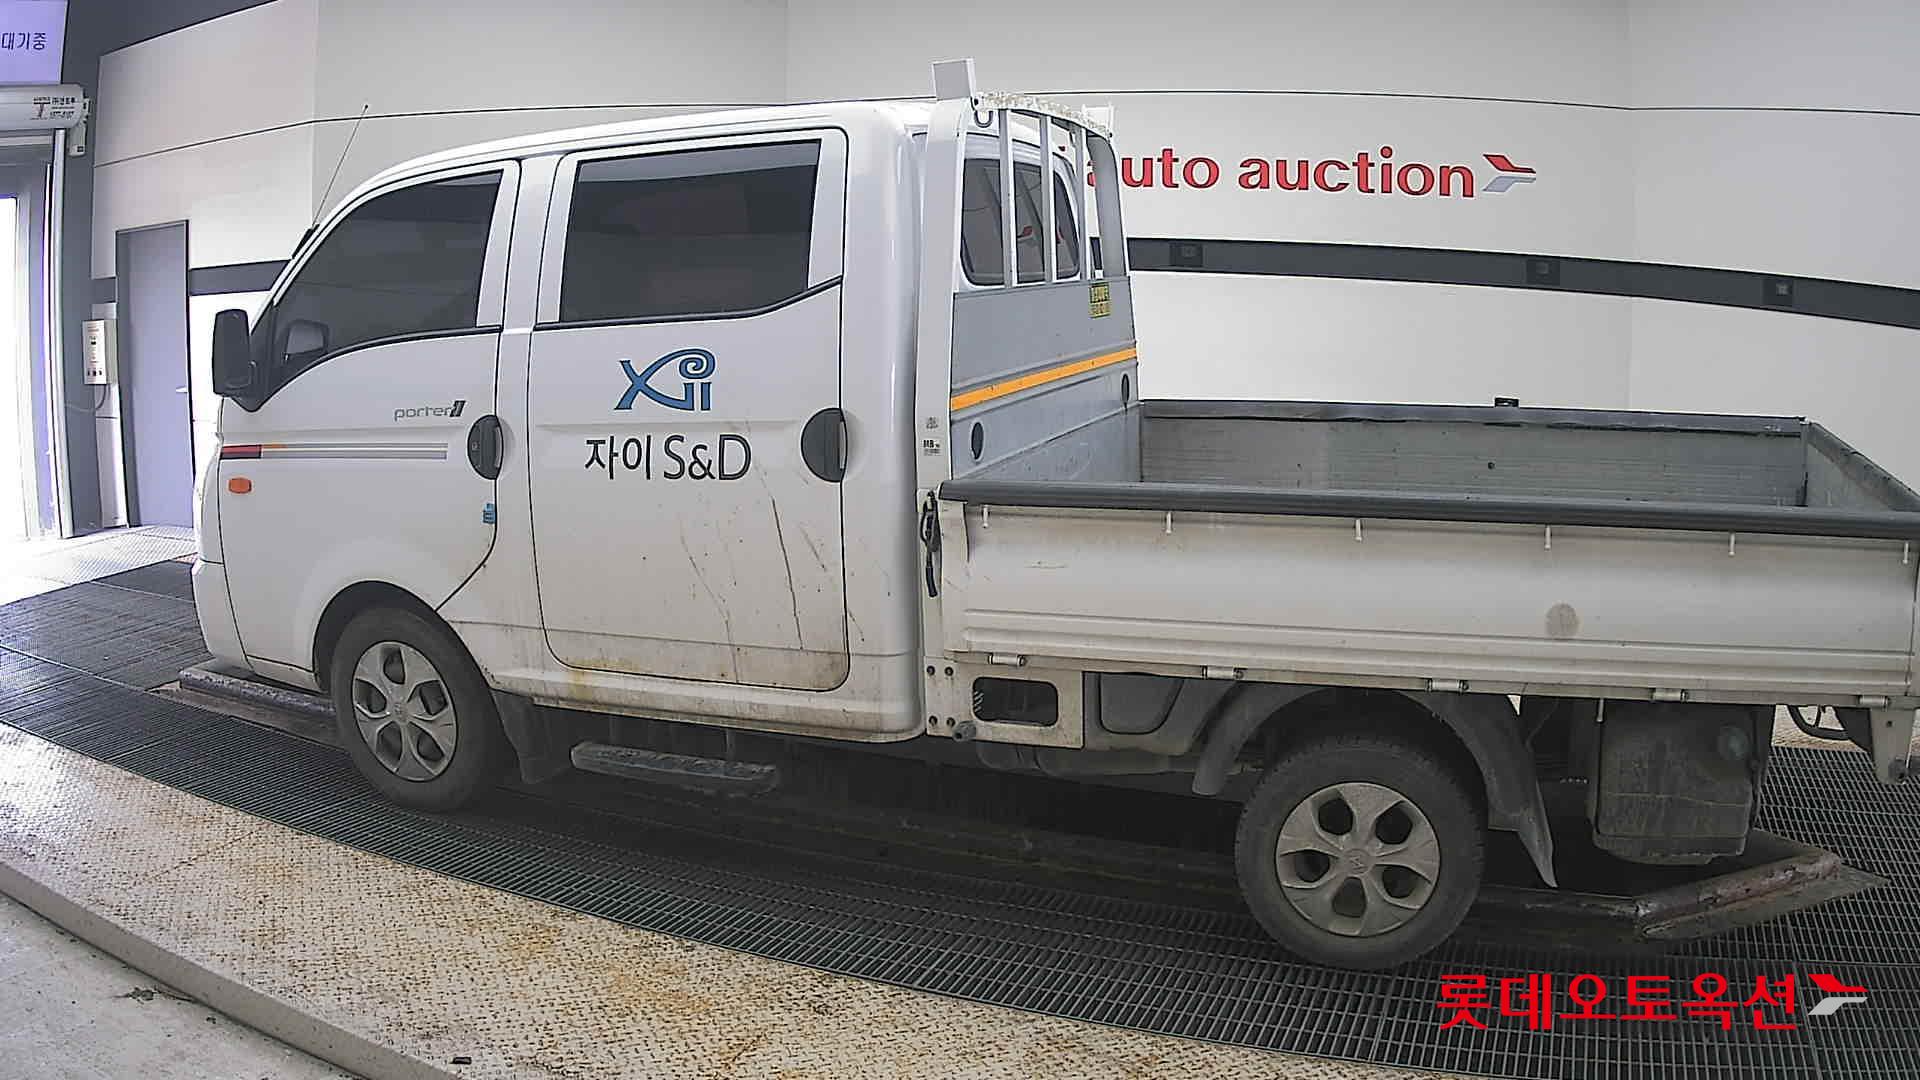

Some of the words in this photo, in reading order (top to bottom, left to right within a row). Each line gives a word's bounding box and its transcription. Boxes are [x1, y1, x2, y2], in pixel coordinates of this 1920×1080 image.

[1, 32, 47, 50] 대기중
[1238, 146, 1475, 198] auction
[585, 436, 652, 480] 자이
[664, 434, 752, 480] S&D
